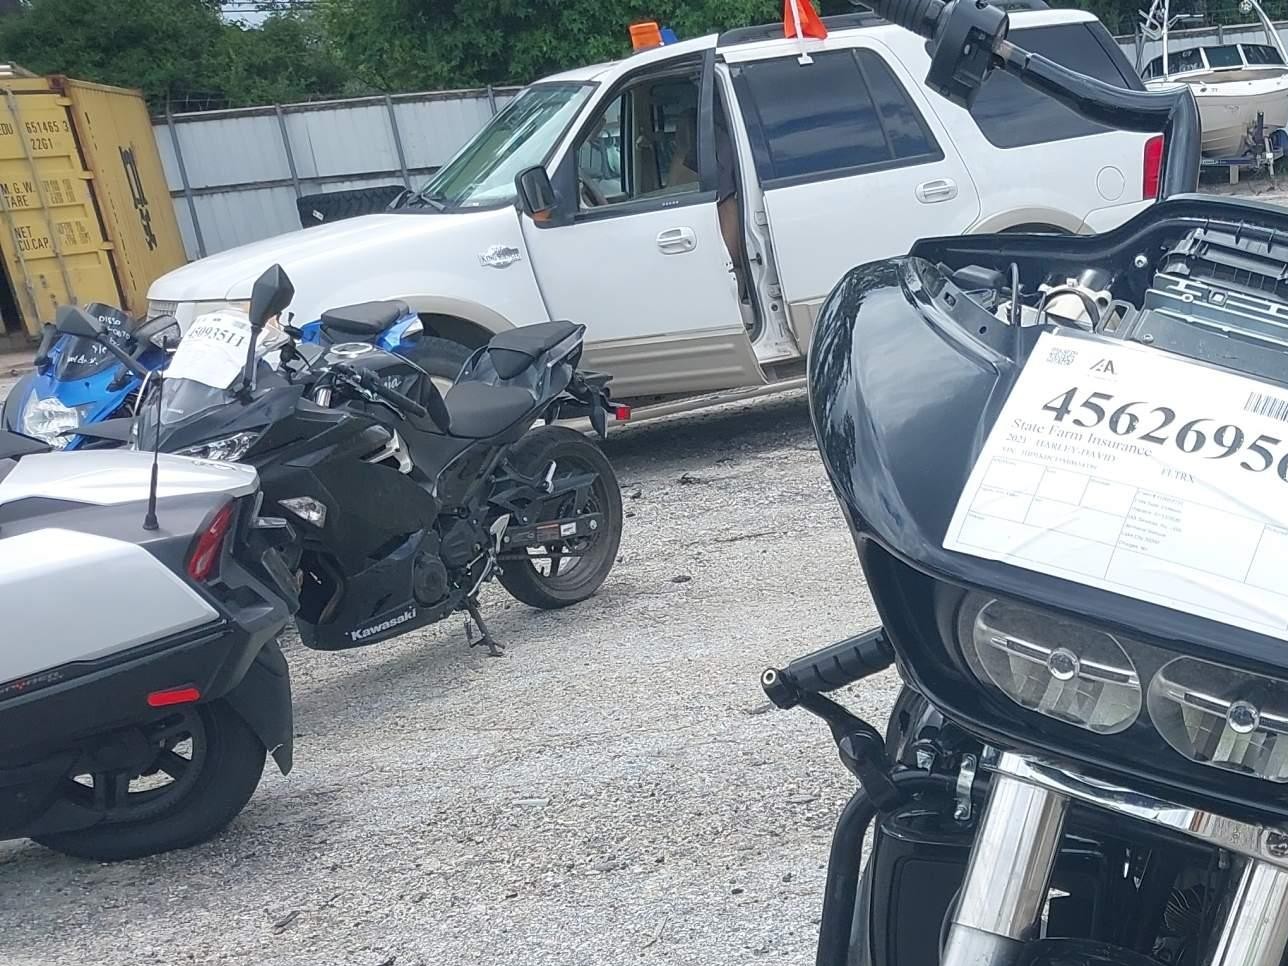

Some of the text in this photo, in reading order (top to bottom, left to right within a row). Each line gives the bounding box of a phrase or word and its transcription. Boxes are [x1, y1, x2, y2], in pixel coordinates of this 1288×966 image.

[4, 194, 30, 208] TARE
[14, 225, 32, 239] NET
[1011, 417, 1153, 458] State Farm Insurance
[350, 605, 417, 641] Kawasaki
